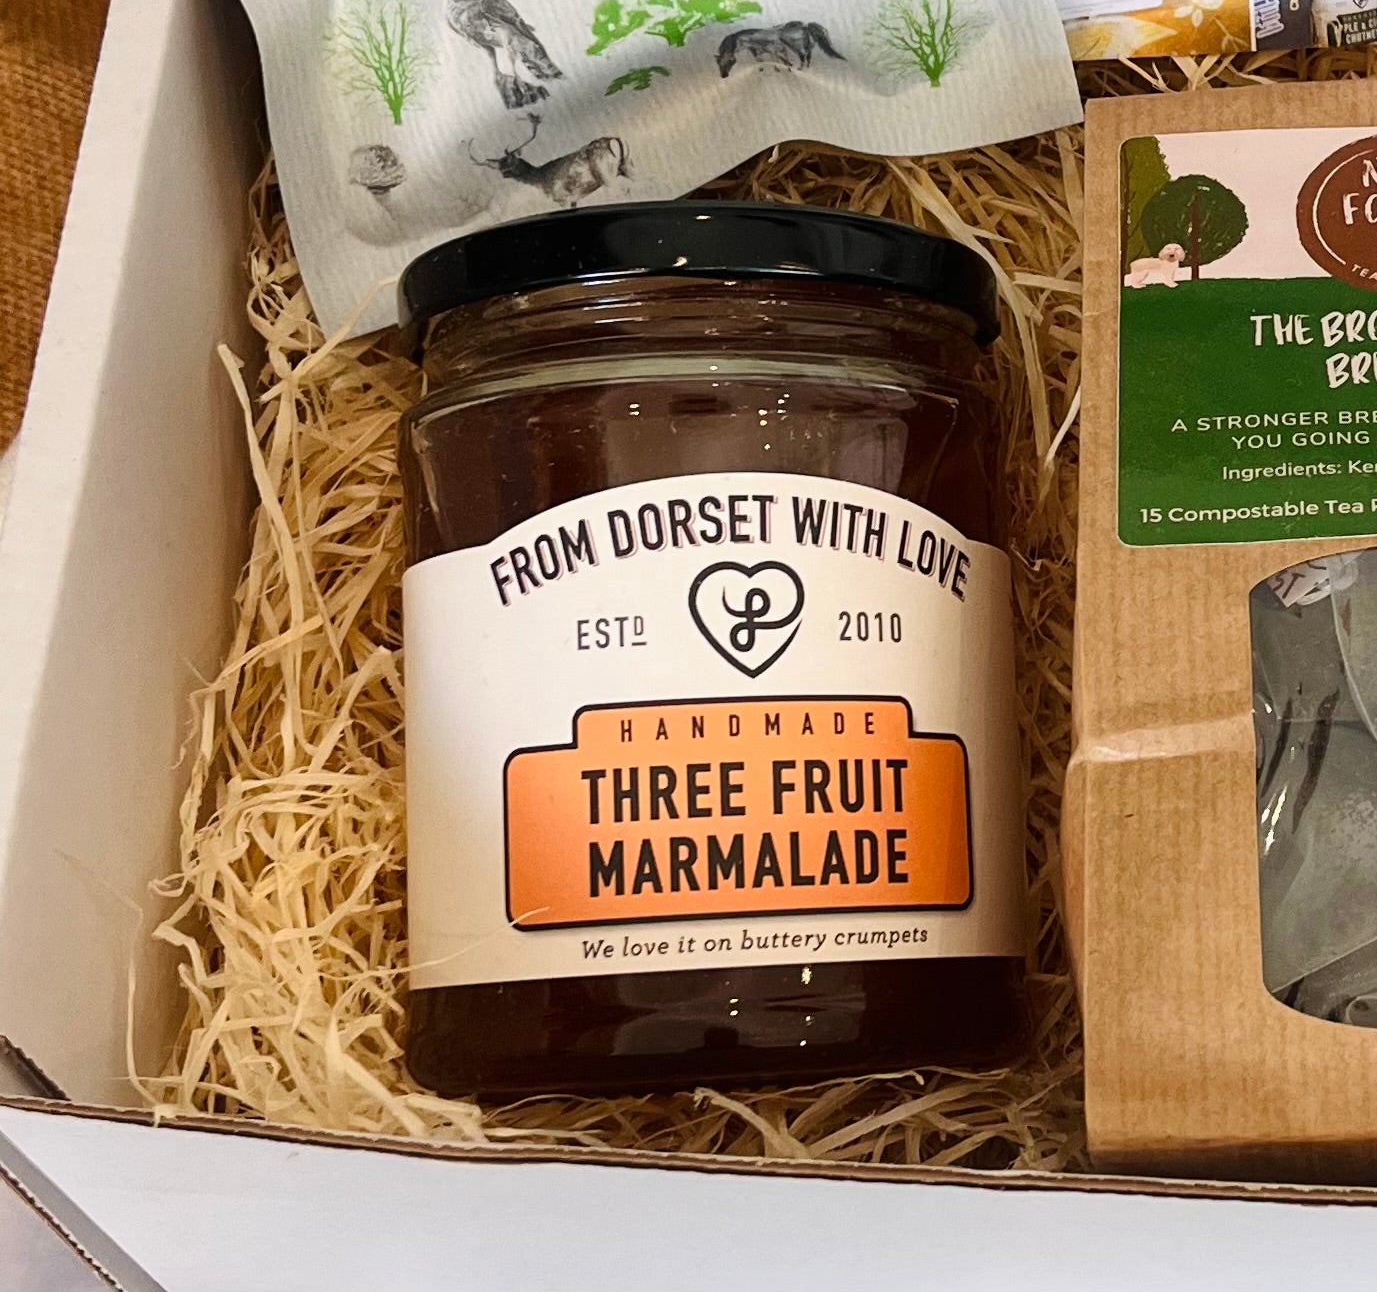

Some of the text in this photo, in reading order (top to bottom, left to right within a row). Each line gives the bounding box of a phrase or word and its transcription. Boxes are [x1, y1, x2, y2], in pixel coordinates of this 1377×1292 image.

[1250, 310, 1316, 348] THE
[1171, 418, 1188, 433] A
[1196, 410, 1330, 432] STRONGER
[1232, 434, 1282, 450] YOU
[1292, 430, 1371, 447] GOING
[1221, 460, 1342, 483] Ingredients:
[1140, 508, 1162, 524] 15
[1168, 500, 1319, 527] Compostable
[1325, 500, 1364, 516] Tea
[490, 494, 972, 607] FROM DORSET WITH LOVE
[838, 612, 902, 644] 2010
[620, 712, 876, 743] HANDMADE
[581, 758, 908, 826] THREE FRUIT
[589, 829, 910, 898] MARMALADE
[582, 926, 928, 959] We love it on buttery crumpets
